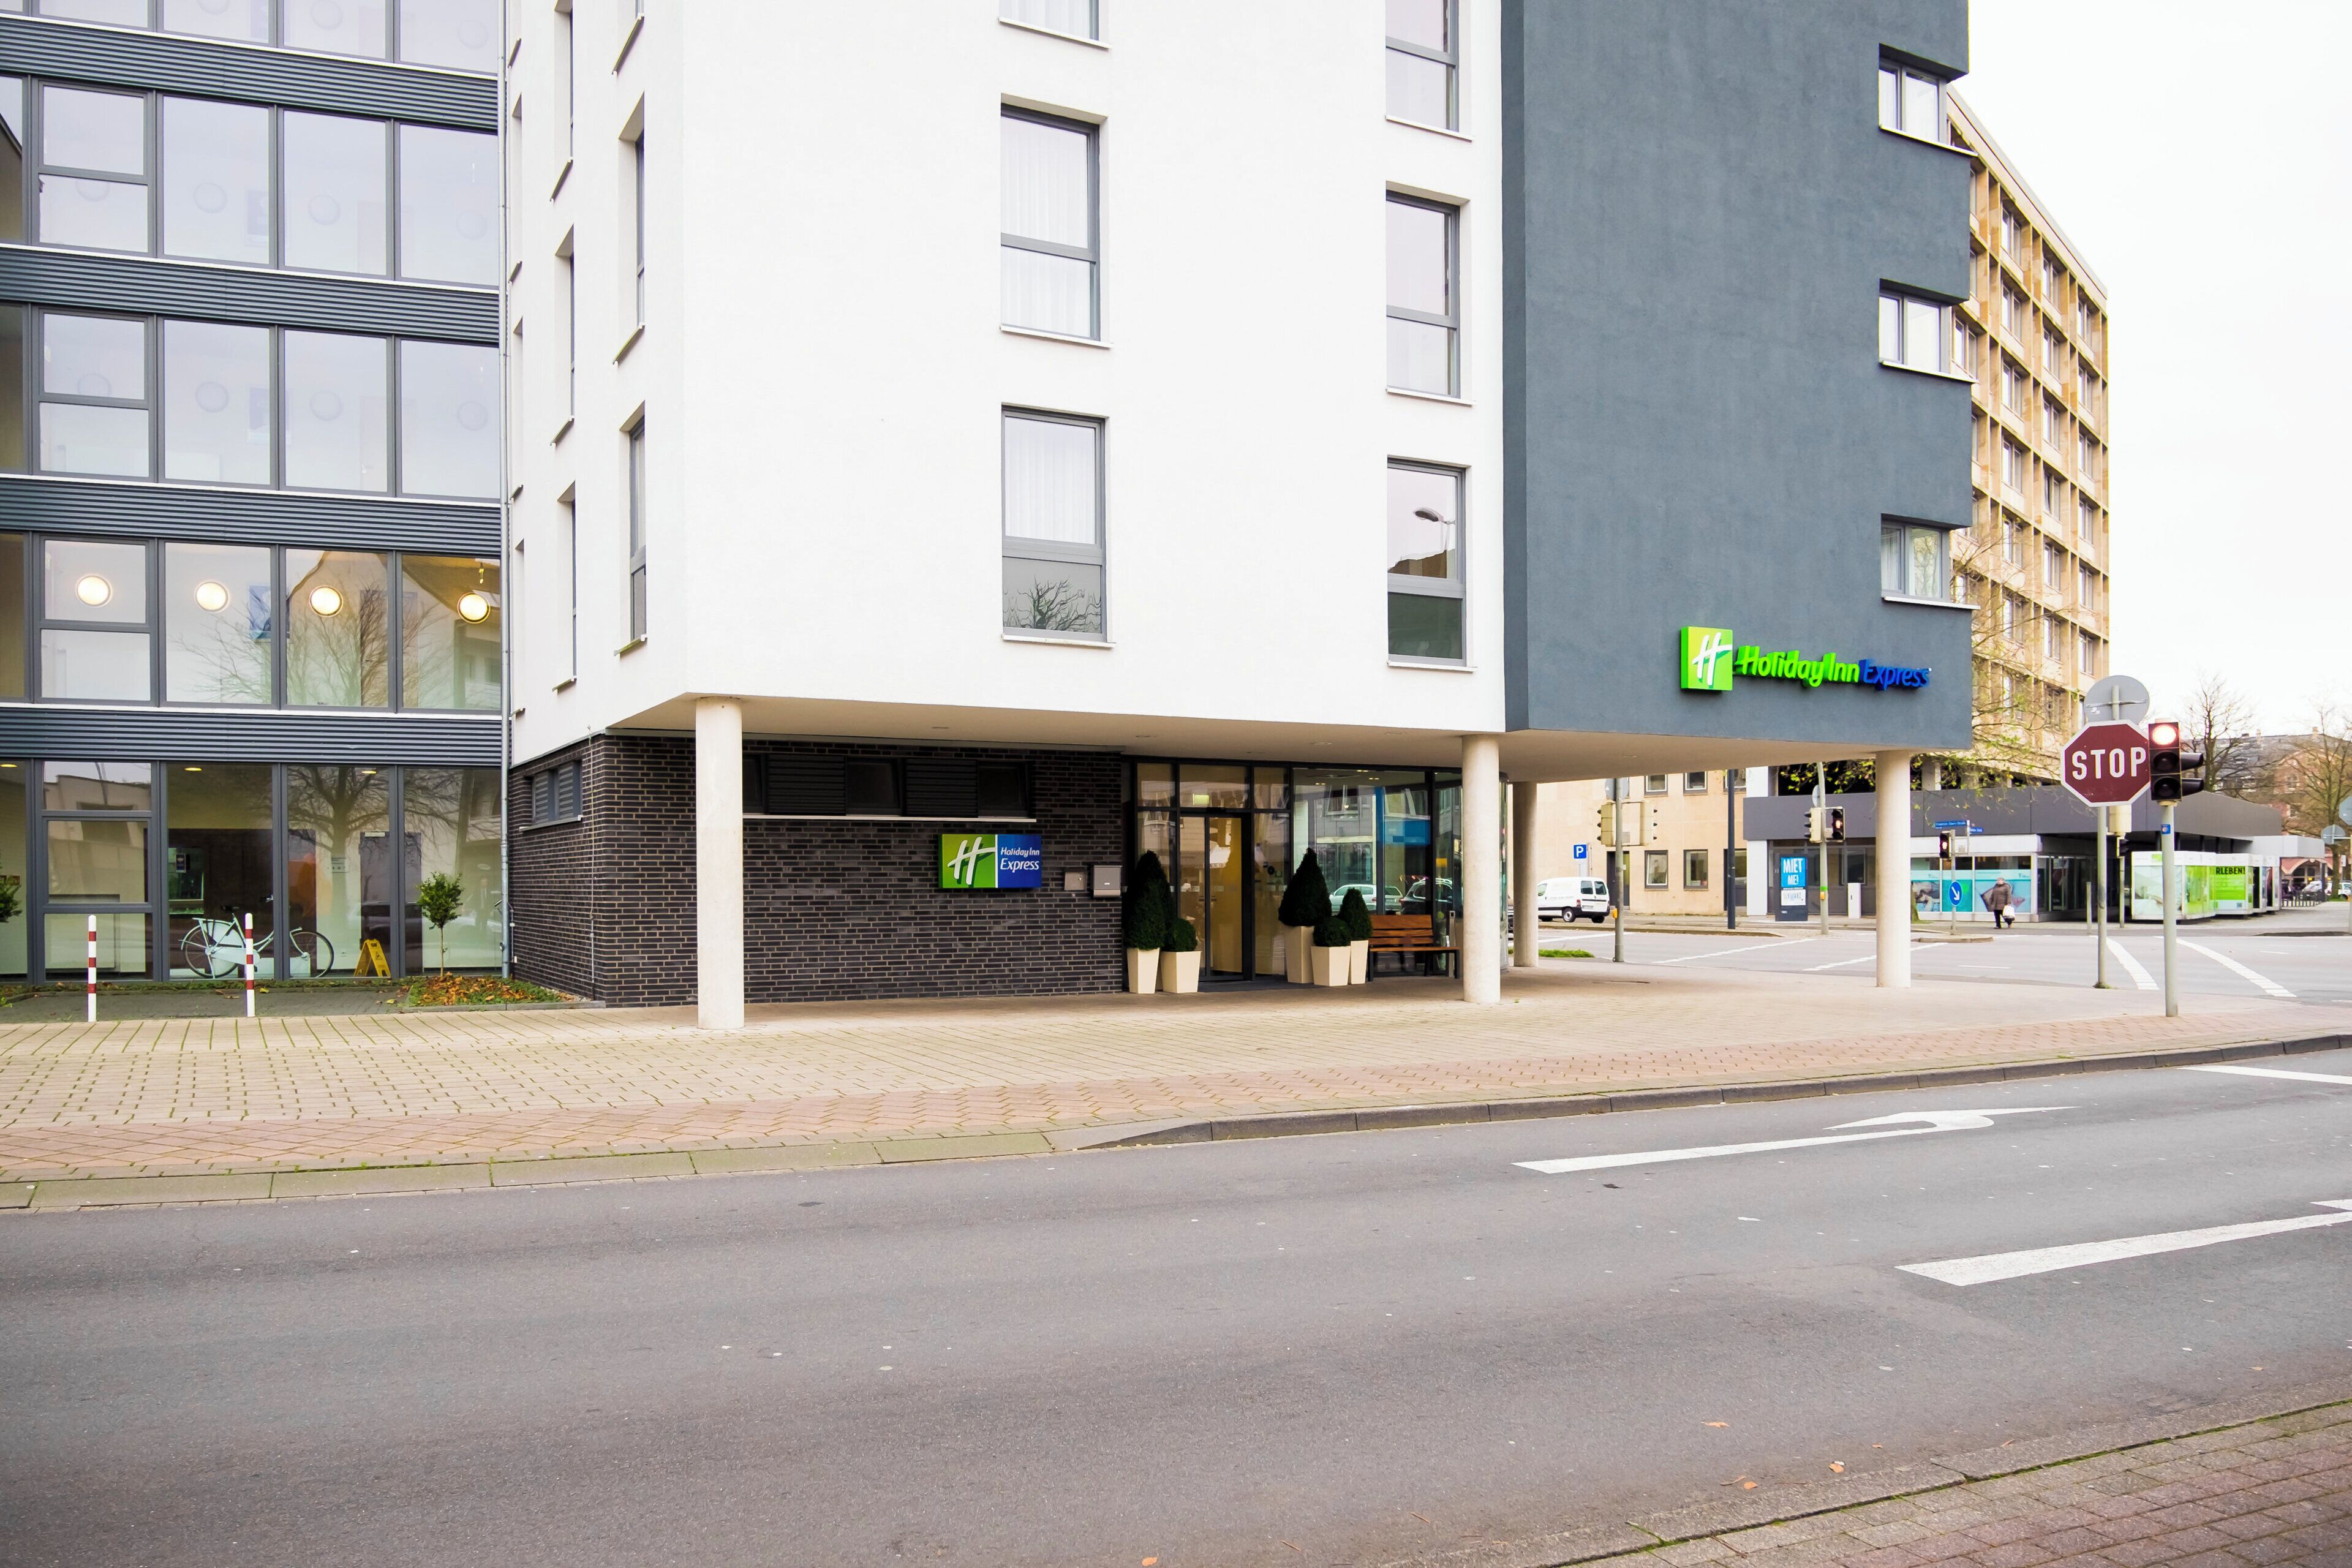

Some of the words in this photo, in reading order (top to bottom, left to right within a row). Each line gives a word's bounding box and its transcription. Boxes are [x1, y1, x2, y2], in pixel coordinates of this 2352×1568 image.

[1735, 645, 1824, 687] Holiday
[1824, 652, 1860, 682] Inn
[1860, 659, 1930, 691] Express
[2072, 747, 2146, 780] STOP
[1000, 846, 1029, 858] Holiday
[1029, 847, 1040, 856] Inn
[1576, 846, 1584, 858] P
[1000, 858, 1039, 873] Express
[1783, 858, 1803, 873] MIET
